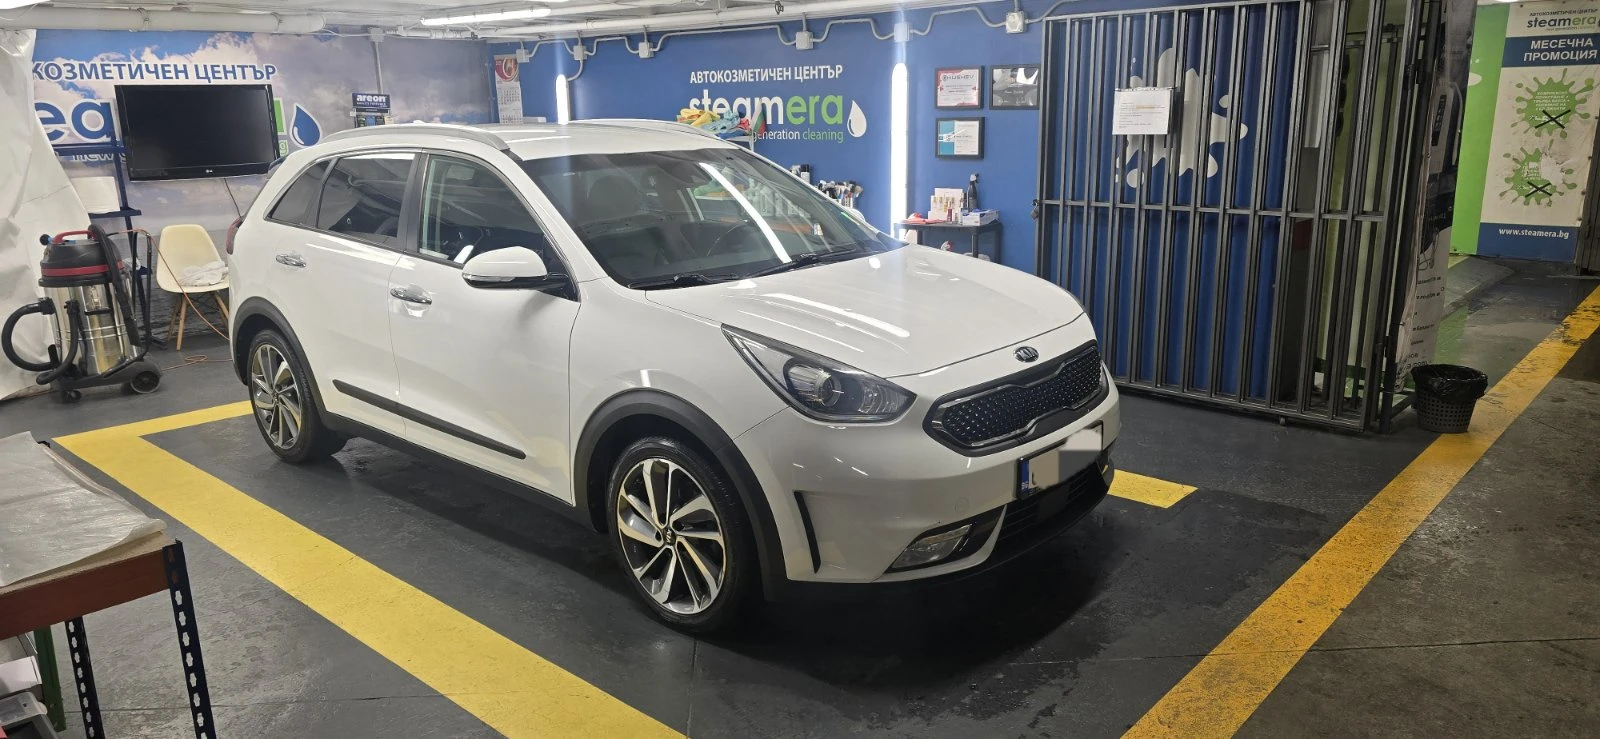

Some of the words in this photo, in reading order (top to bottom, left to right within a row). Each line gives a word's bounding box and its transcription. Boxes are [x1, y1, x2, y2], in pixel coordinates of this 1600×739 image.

[1527, 16, 1596, 28] steamera
[1530, 37, 1594, 49] МЕСЕЧНА
[1523, 50, 1598, 61] ПРОМОЦИЯ
[195, 64, 277, 83] ЦЕНТЪР
[690, 67, 792, 84] АВТОКОЗМЕТИЧЕН
[794, 65, 843, 83] ЦЕНТЪР
[803, 128, 844, 142] cleaning
[1499, 228, 1570, 239] www.steamera.bg
[1016, 347, 1038, 361] KIA
